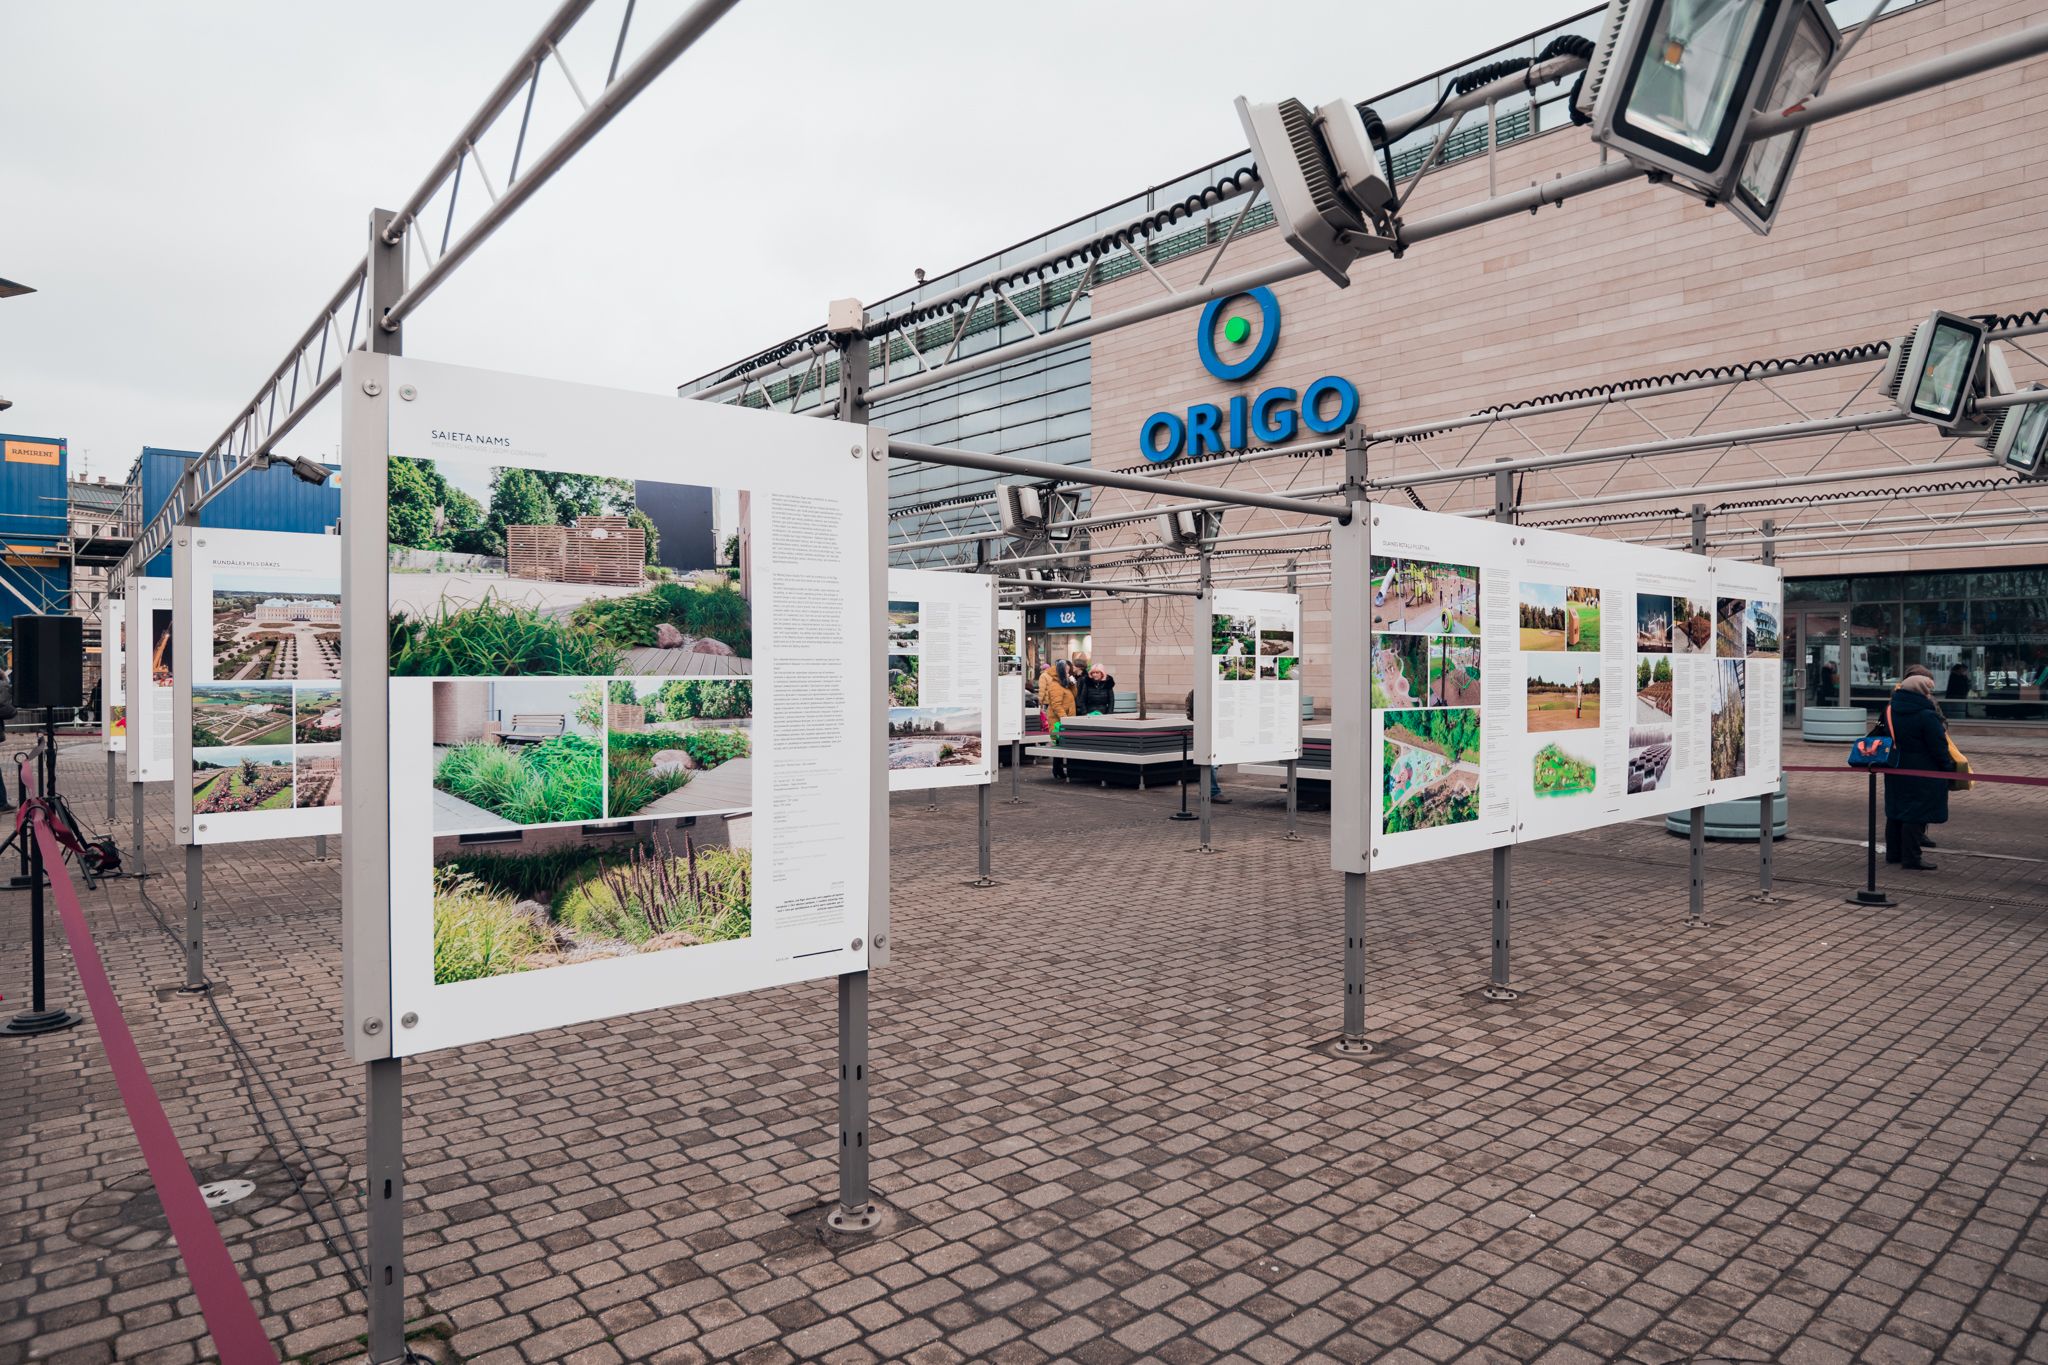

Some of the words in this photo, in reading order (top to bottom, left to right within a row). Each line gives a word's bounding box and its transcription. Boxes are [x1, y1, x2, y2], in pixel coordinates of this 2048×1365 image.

[1139, 375, 1360, 463] ORIGO
[431, 430, 473, 442] SAIETA
[476, 435, 511, 446] NAMS
[11, 448, 54, 458] RAMIRENT
[1060, 611, 1077, 624] tet
